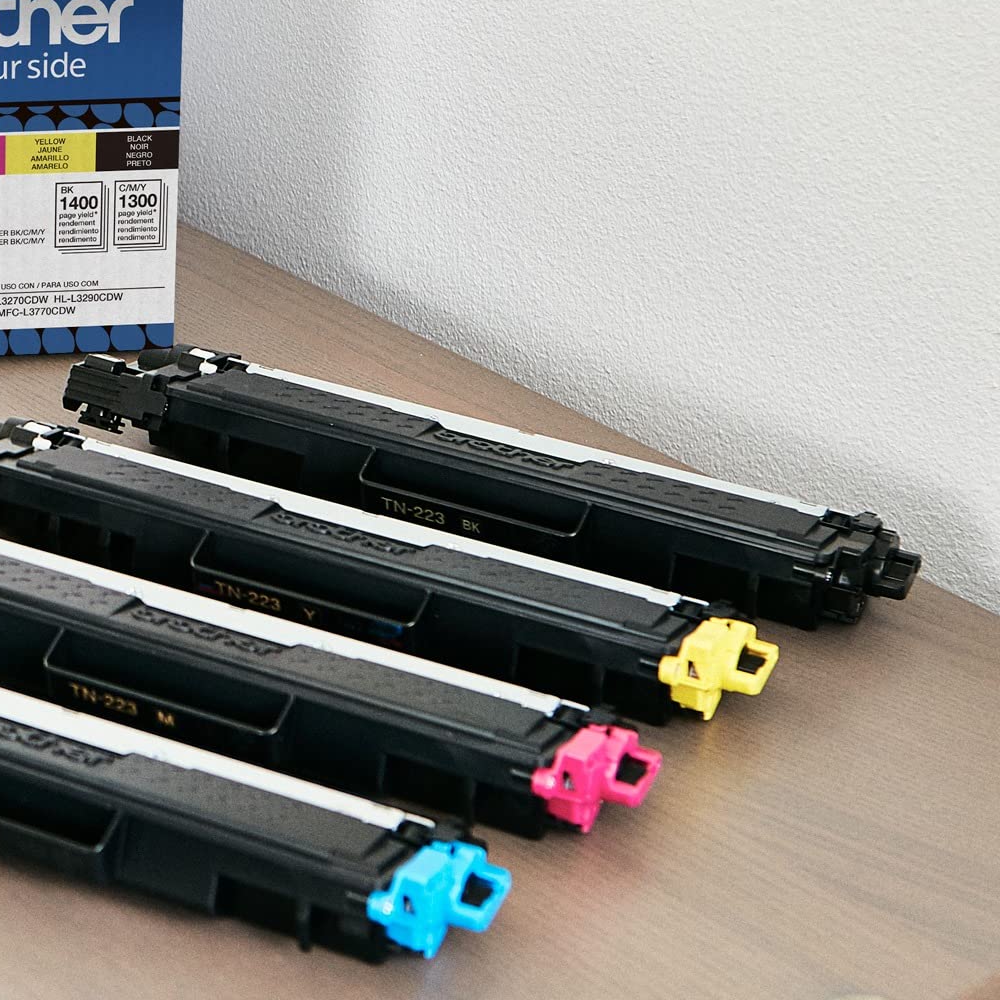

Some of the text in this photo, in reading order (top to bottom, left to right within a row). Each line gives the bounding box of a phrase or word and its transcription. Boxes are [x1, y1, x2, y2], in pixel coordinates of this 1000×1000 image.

[27, 51, 87, 80] side
[35, 138, 66, 146] YELLOW
[37, 146, 63, 154] JAUNE
[30, 154, 70, 162] AMARILLO
[125, 151, 153, 159] NEGRO
[31, 162, 69, 170] AMARELO
[60, 186, 74, 194] BK
[118, 184, 147, 192] C/M/Y
[60, 195, 99, 210] 1400
[119, 193, 158, 208] 1300
[58, 212, 76, 220] page
[117, 210, 135, 218] page
[58, 219, 96, 227] rendement
[117, 217, 154, 225] rendement
[10, 228, 46, 236] BK/C/M/Y
[58, 227, 99, 235] rendimiento
[117, 225, 158, 233] rendimiento
[10, 237, 46, 245] BK/C/M/Y
[117, 233, 156, 241] rendimento
[18, 282, 35, 290] CON
[63, 280, 79, 288] USO
[53, 292, 124, 303] HL-L3290CDW
[433, 429, 576, 470] brother
[381, 496, 480, 534] TN-223 BK
[215, 580, 316, 620] TN-223 Y
